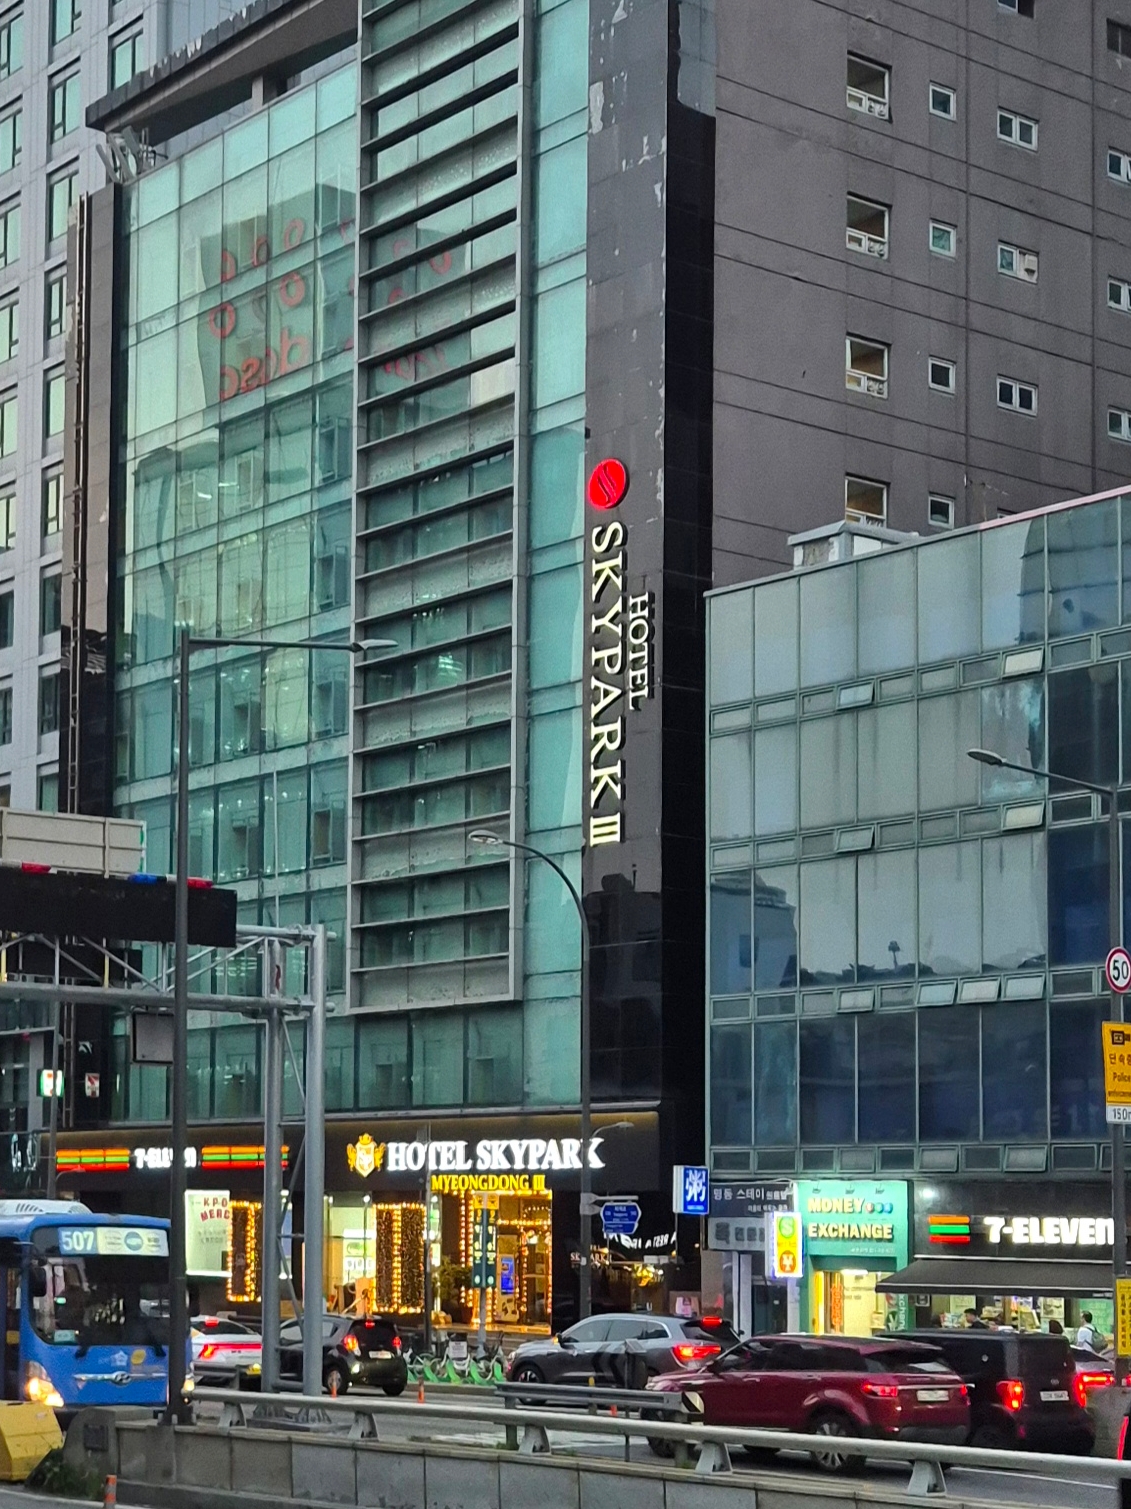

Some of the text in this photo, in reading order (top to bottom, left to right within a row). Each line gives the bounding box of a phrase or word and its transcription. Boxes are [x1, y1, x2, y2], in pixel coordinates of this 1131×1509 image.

[629, 591, 649, 711] HOTEL
[590, 520, 624, 809] SKYPARK
[1111, 959, 1130, 981] 50
[386, 1137, 606, 1171] HOTEL SKYPARK
[430, 1175, 530, 1191] MYEONGDONG
[713, 1188, 734, 1200] 명동
[735, 1187, 765, 1200] 스테이
[807, 1197, 866, 1214] MONEY
[61, 1231, 96, 1252] 507
[807, 1222, 894, 1240] EXCHANGE
